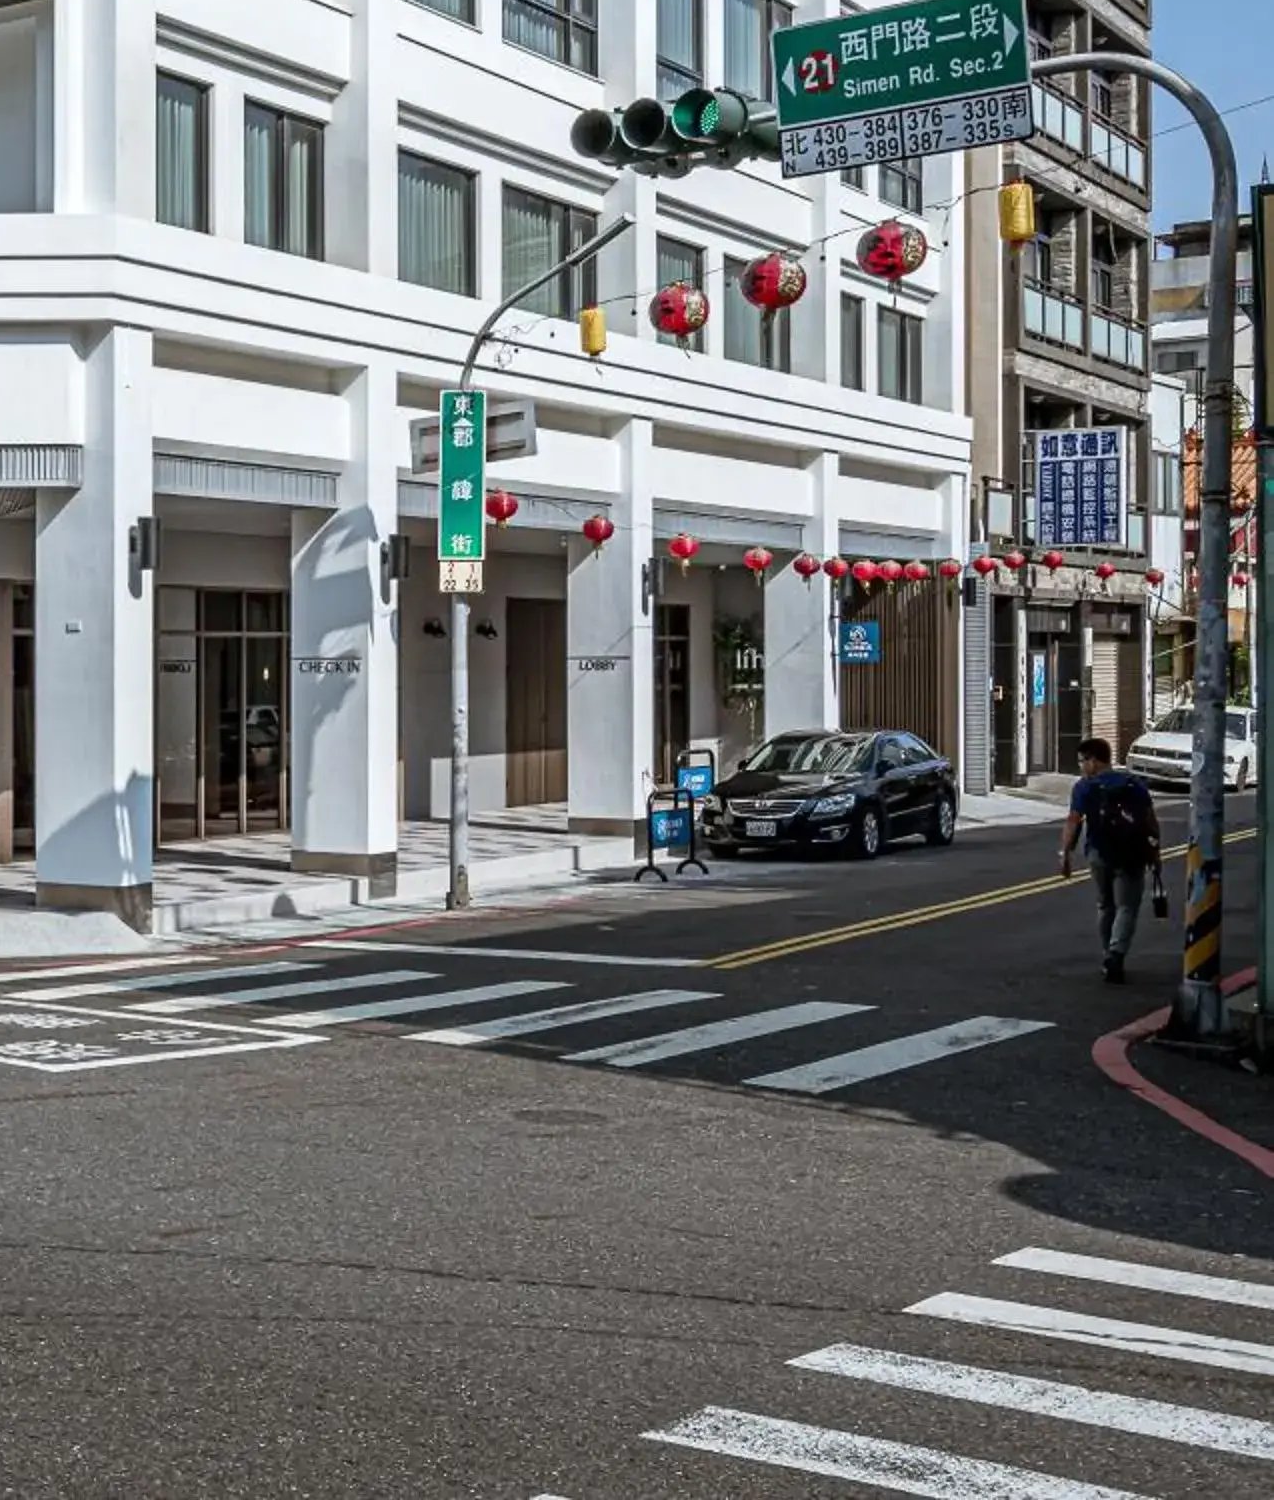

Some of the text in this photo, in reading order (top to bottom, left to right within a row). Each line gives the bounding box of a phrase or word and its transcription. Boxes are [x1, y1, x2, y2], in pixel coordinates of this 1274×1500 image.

[839, 3, 999, 65] 西門路二段
[801, 54, 835, 89] 21
[843, 51, 1004, 99] Simen Rd. Sec.2
[1001, 93, 1027, 121] 南
[784, 132, 809, 157] 北
[1041, 431, 1118, 459] 如意通訊
[298, 660, 361, 674] CHECK IN
[578, 659, 617, 671] LOBBY
